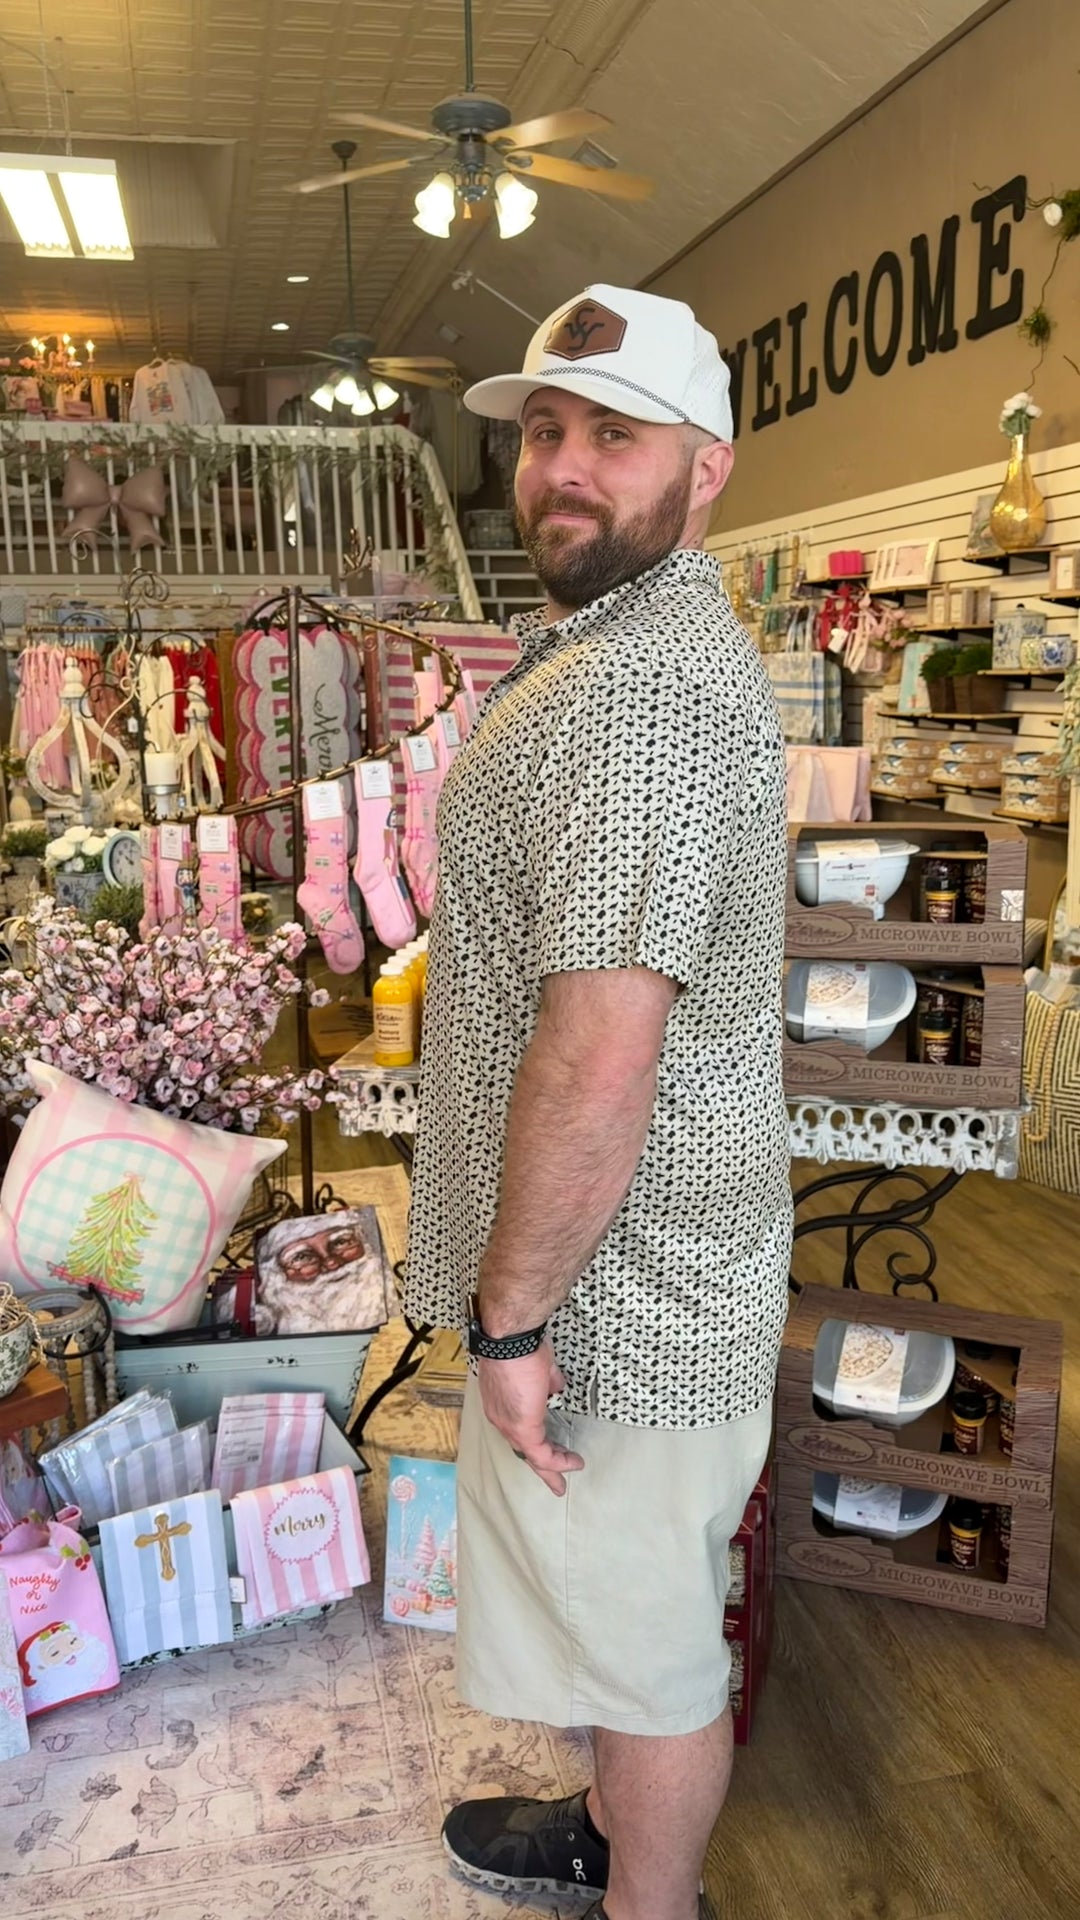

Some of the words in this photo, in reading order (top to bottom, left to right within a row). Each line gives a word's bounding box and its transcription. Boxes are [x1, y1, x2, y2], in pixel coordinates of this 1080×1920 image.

[860, 927, 962, 943] MICROWAVE
[966, 930, 1016, 944] BOWL
[907, 943, 935, 952] GIFT
[937, 944, 961, 953] SET
[852, 1066, 958, 1085] MICROWAVE
[961, 1073, 1014, 1089] BOWL
[901, 1084, 930, 1094] GIFT
[932, 1086, 957, 1096] SET
[880, 1451, 988, 1483] MICROWAVE
[991, 1473, 1046, 1494] BOWL
[930, 1474, 960, 1490] GIFT
[962, 1481, 987, 1494] SET
[274, 1512, 325, 1537] Merry
[9, 1572, 61, 1592] Naughty
[877, 1566, 984, 1599] MICROWAVE
[986, 1588, 1041, 1609] BOWL
[26, 1589, 41, 1600] or
[926, 1588, 957, 1604] GIFT
[958, 1595, 983, 1609] SET
[20, 1603, 48, 1615] Nice
